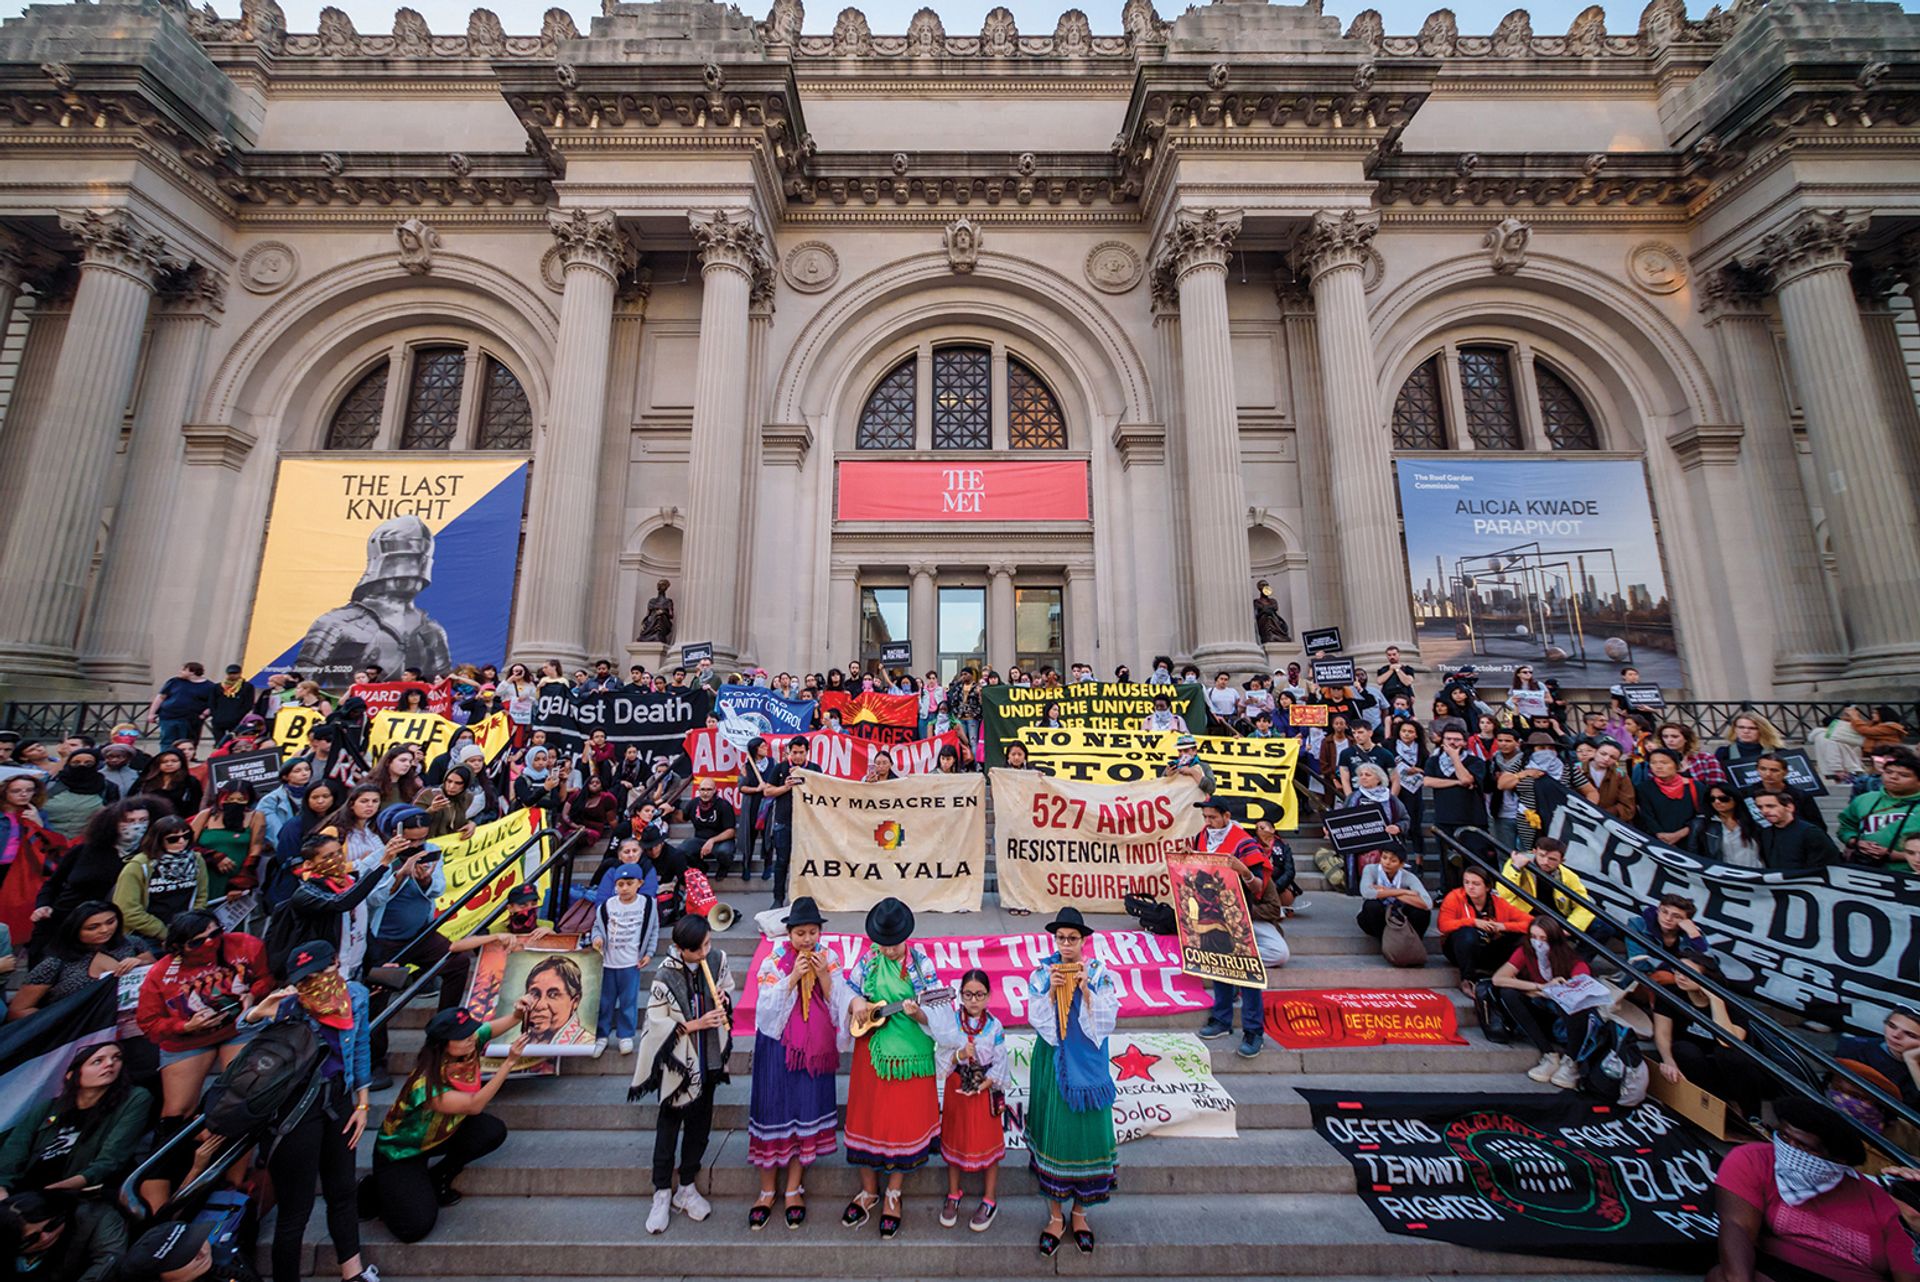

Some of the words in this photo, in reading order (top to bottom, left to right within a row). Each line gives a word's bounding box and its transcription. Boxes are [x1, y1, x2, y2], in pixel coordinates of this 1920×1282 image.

[342, 475, 390, 496] THE
[400, 475, 464, 497] LAST
[942, 470, 985, 491] THE
[1414, 482, 1460, 490] Commission
[345, 499, 450, 520] KNIGHT
[942, 491, 986, 513] MET
[1455, 500, 1522, 515] ALICJA
[1527, 500, 1599, 515] KWADE
[1473, 519, 1583, 535] PARAPIVOT
[1437, 664, 1468, 673] Throu
[1009, 687, 1064, 702] UNDER
[1067, 684, 1098, 698] THE
[1102, 683, 1177, 698] MUSEUM
[614, 698, 693, 724] Death
[1000, 703, 1045, 718] UNDE
[1056, 700, 1088, 716] THE
[1092, 699, 1190, 715] UNIVERTY
[387, 717, 446, 743] THE
[1089, 717, 1119, 731] THE
[1025, 731, 1072, 746] NO
[1083, 732, 1163, 750] NEW
[1198, 741, 1287, 758] AILS
[1125, 752, 1166, 761] ON
[802, 792, 840, 808] HAY
[848, 795, 946, 810] MASACRE
[953, 795, 978, 808] EN
[1032, 793, 1087, 830] 527
[1096, 794, 1175, 835] AÑOS
[1007, 838, 1120, 865] RESISTENCIA
[1125, 834, 1197, 863] INDÍGEN
[800, 860, 884, 881] ABYA
[893, 860, 972, 879] YALA
[1046, 873, 1170, 899] SEGUIREMOS
[999, 933, 1054, 967] TH
[1185, 947, 1262, 973] CONSTRUIR
[1344, 1014, 1401, 1029] DEFENSE
[1325, 1116, 1442, 1144] DEFEND
[1559, 1119, 1641, 1148] FIGHT
[1625, 1103, 1680, 1143] FOR
[1353, 1153, 1465, 1186] TENANT
[1610, 1148, 1718, 1202] BLACK
[1378, 1195, 1506, 1221] RIGHTS!
